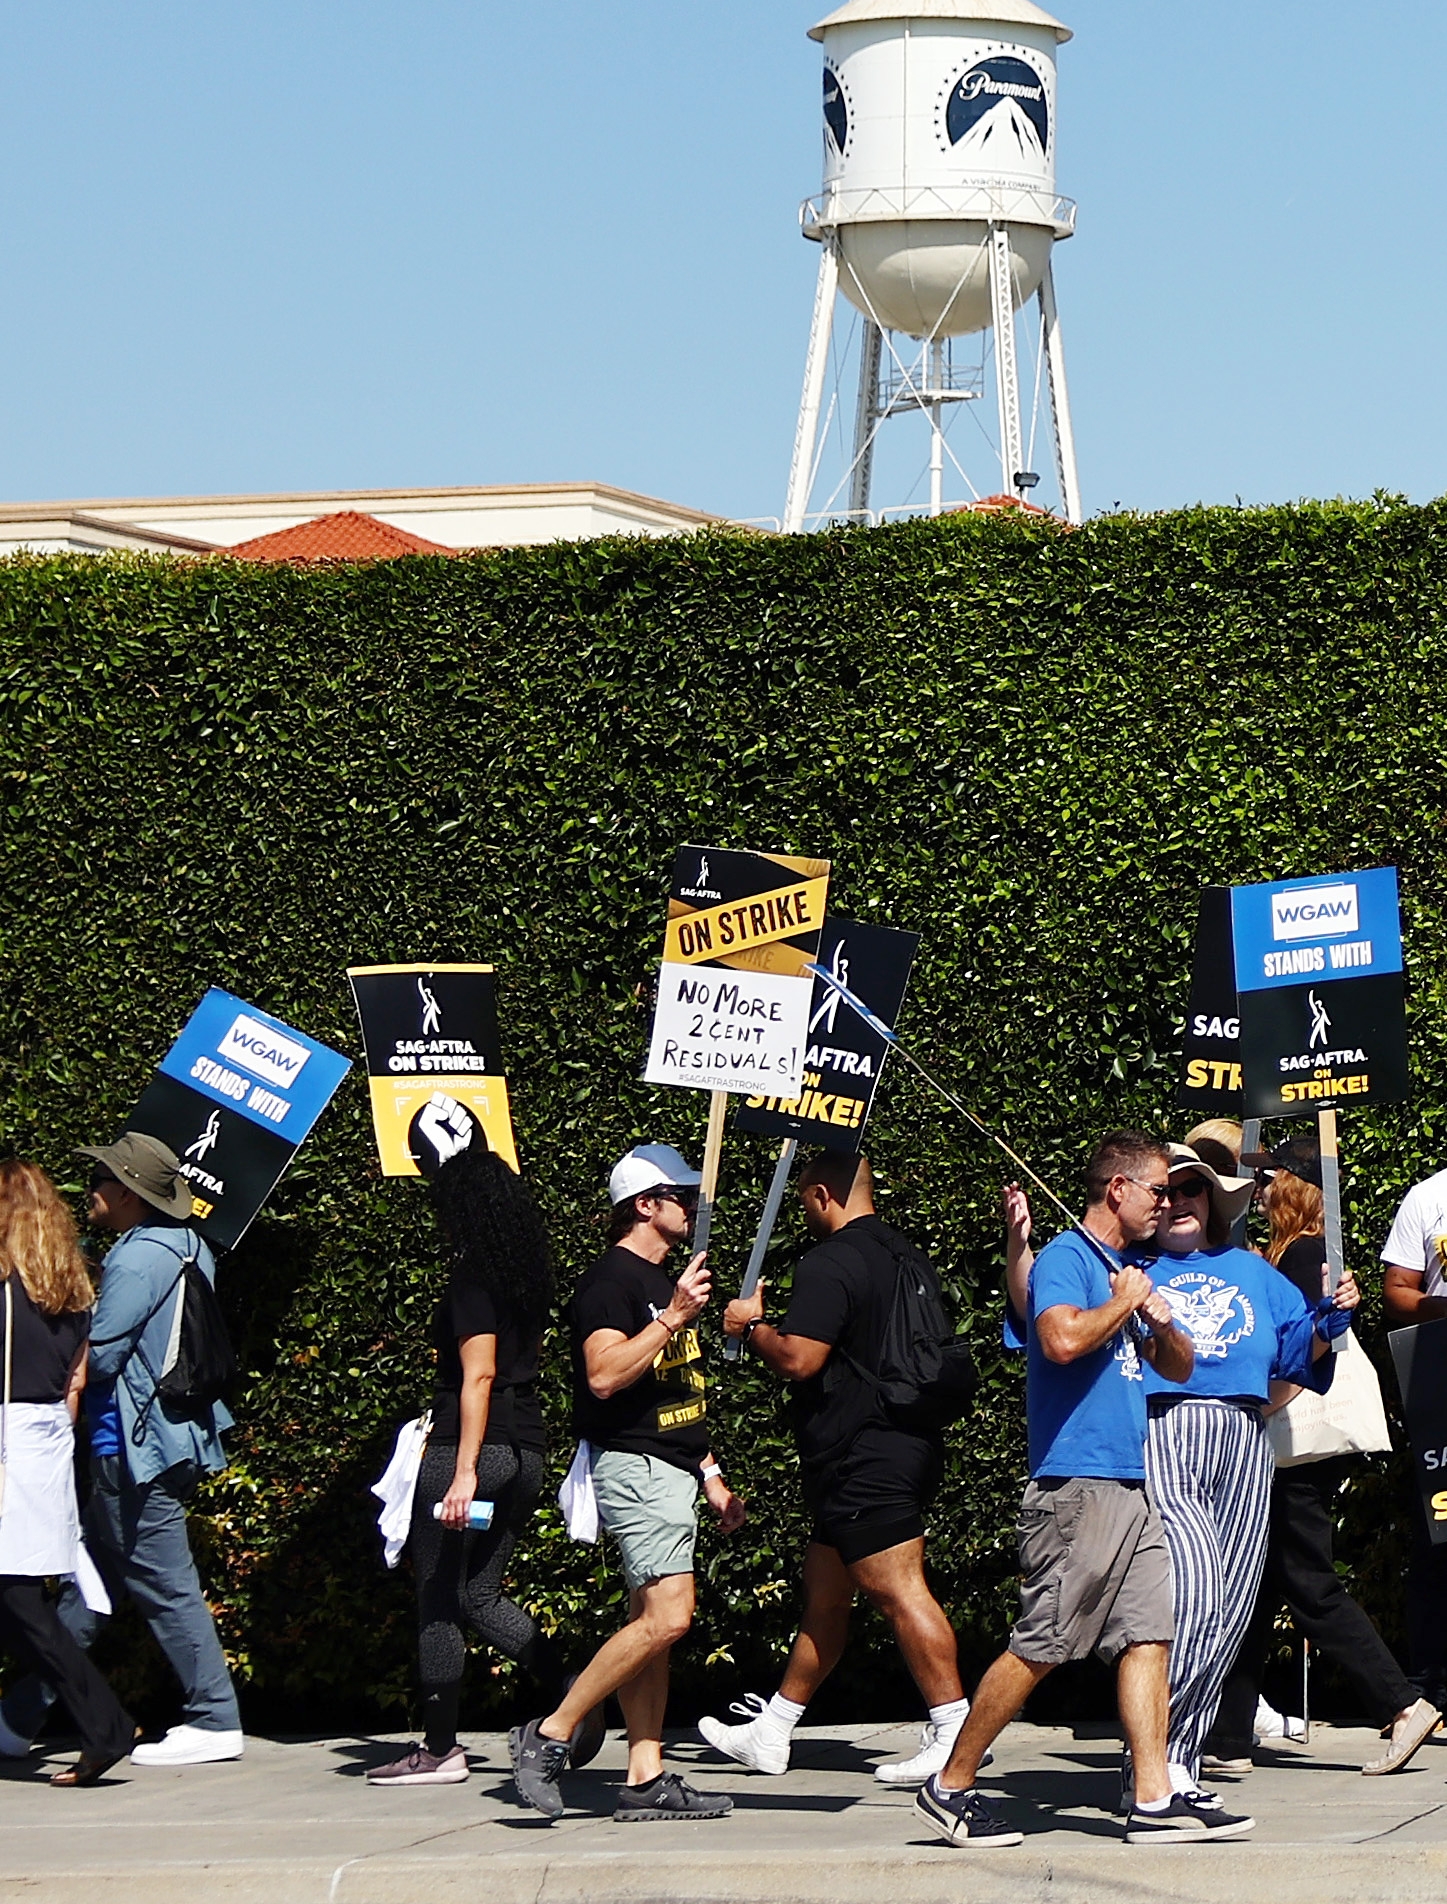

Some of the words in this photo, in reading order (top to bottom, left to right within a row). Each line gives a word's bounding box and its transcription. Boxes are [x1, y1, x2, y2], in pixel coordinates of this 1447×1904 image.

[959, 70, 1042, 102] Paramount
[678, 919, 712, 957] ON
[718, 890, 812, 946] STRIKE
[1277, 899, 1353, 924] WGAW
[1263, 946, 1325, 978] STANDS
[1329, 940, 1373, 969] WITH
[677, 979, 710, 1005] NO
[712, 983, 784, 1022] MORE
[688, 1014, 703, 1039] 2
[232, 1028, 299, 1073] WGAW
[388, 1055, 418, 1072] ON
[419, 1055, 486, 1072] STRIKE!
[662, 1039, 798, 1083] RESIDUALS!
[393, 1079, 487, 1090] #SAGAFTRASTRONG
[678, 1073, 767, 1092] #SAGAFTRASTRONG
[1280, 1074, 1370, 1103] STRIKE!
[1313, 1068, 1332, 1080] ON
[190, 1055, 250, 1102] STANDS
[246, 1085, 292, 1124] WITH
[1169, 1272, 1207, 1288] GUILD
[1208, 1275, 1226, 1288] OF
[1235, 1293, 1255, 1337] AMERICA
[660, 1411, 675, 1427] ON
